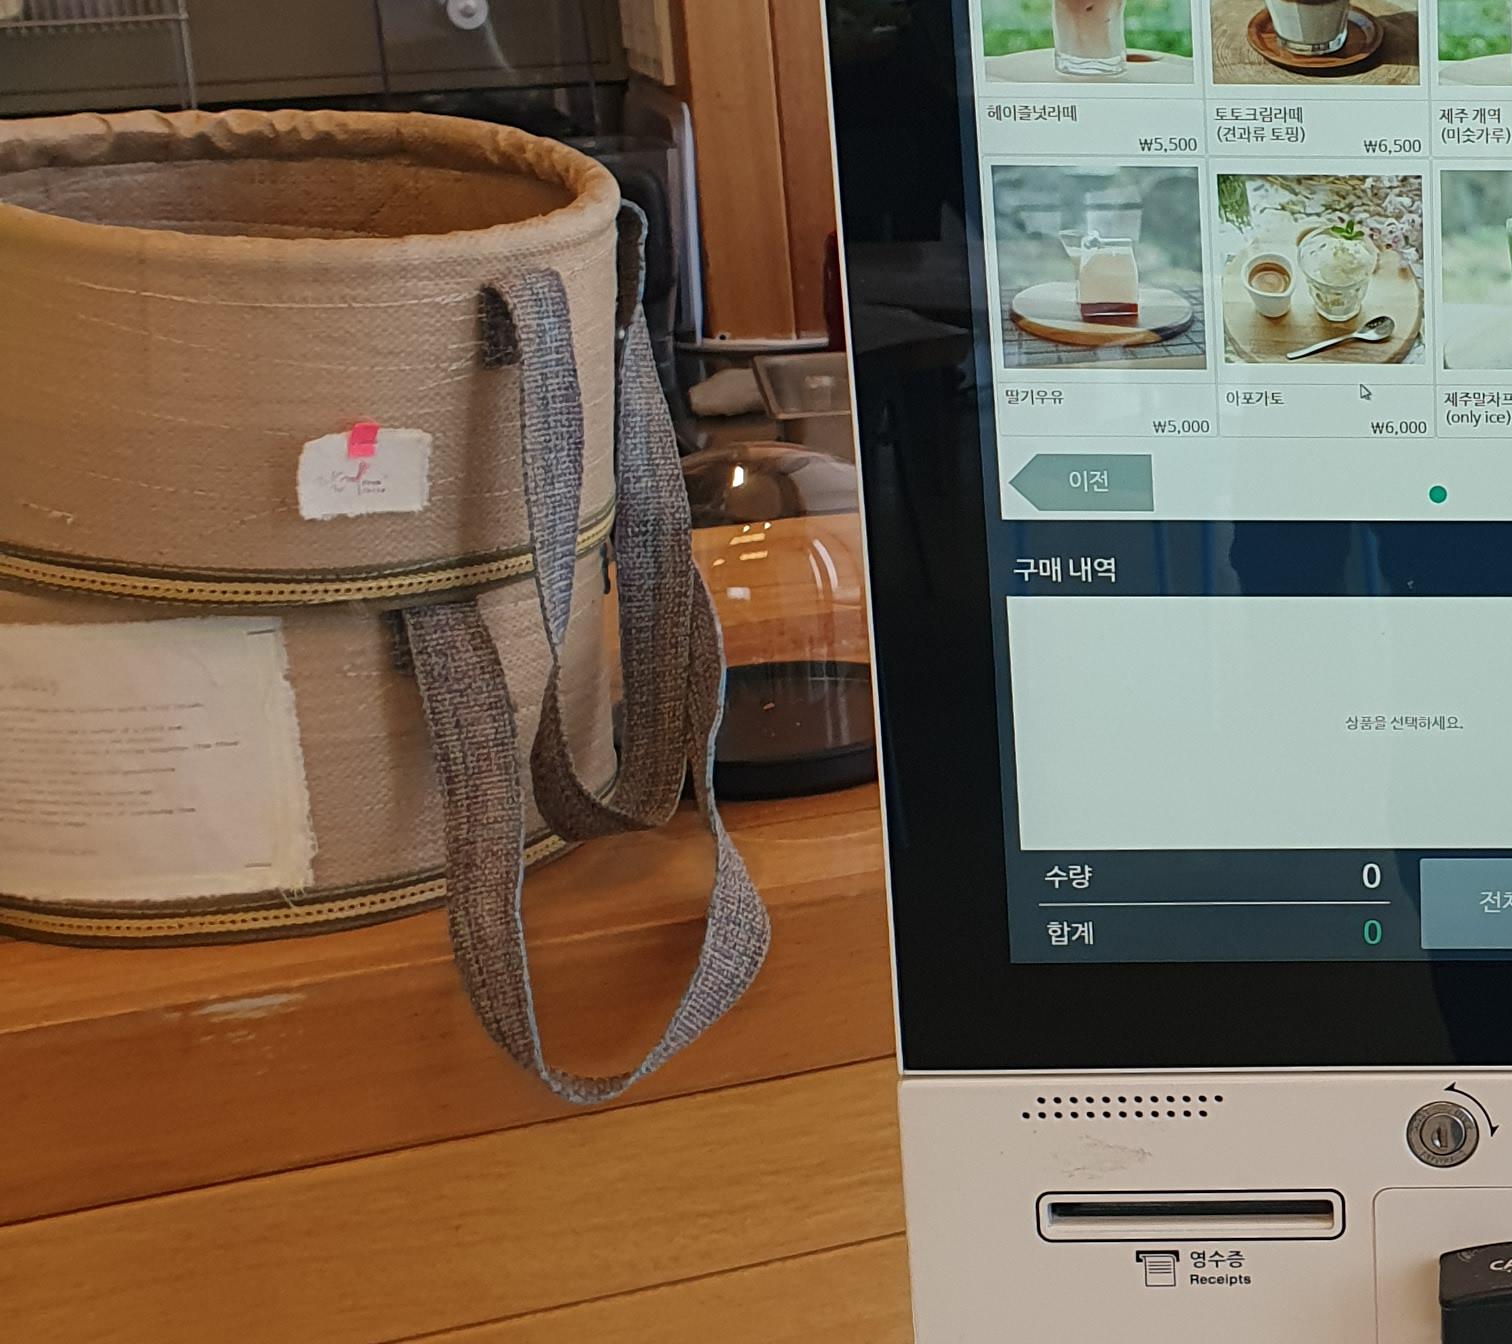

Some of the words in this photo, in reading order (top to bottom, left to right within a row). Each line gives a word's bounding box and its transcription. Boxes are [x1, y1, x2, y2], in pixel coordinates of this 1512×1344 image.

[987, 105, 1077, 121] 헤이즐넛라떼
[1214, 107, 1303, 123] 토토크림라떼
[1440, 108, 1468, 124] 제주
[1472, 108, 1500, 124] 개역
[1271, 127, 1305, 143] 토핑)
[1441, 127, 1511, 144] (미숫가루)
[1006, 389, 1064, 405] 딸기우유
[1227, 391, 1284, 406] 아포가토
[1447, 410, 1481, 427] (only
[1485, 410, 1511, 425] ice)
[1070, 470, 1108, 492] 이전
[1014, 557, 1061, 582] 구매
[1069, 558, 1115, 582] 내역
[1346, 716, 1386, 731] 상품을
[1391, 715, 1463, 730] 선택하세요.
[1045, 865, 1092, 888] 수량
[1363, 864, 1380, 888] 0
[1047, 922, 1093, 945] 합계
[1362, 919, 1383, 945] 0
[1191, 1251, 1245, 1268] 영수증
[1190, 1274, 1251, 1286] Receipts
